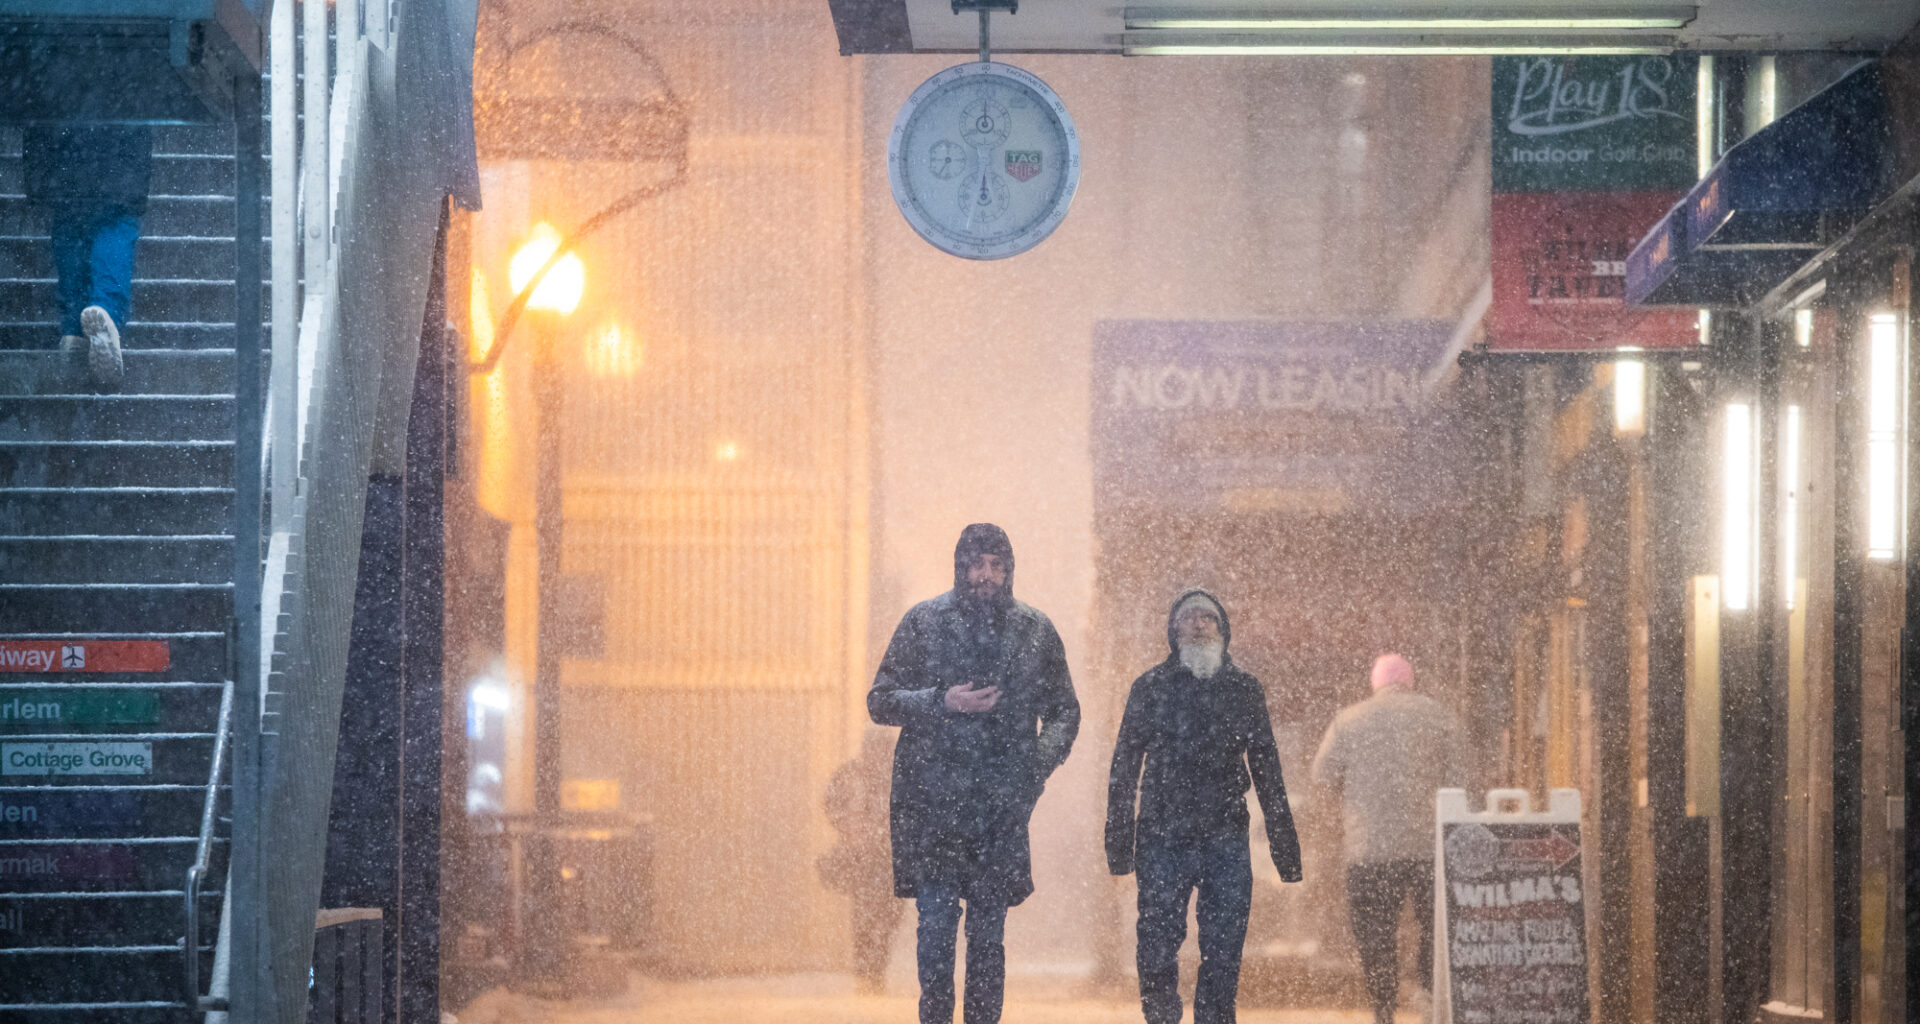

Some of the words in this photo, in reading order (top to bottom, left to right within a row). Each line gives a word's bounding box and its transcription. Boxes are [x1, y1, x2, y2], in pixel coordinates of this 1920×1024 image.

[1010, 152, 1040, 163] TAG
[1512, 147, 1593, 163] Indoor
[1599, 147, 1637, 163] Golf
[1109, 364, 1245, 409] NOW
[9, 751, 84, 771] Cottage
[89, 751, 145, 768] Grove
[0, 801, 38, 823] en
[1452, 873, 1582, 908] WILMA'S
